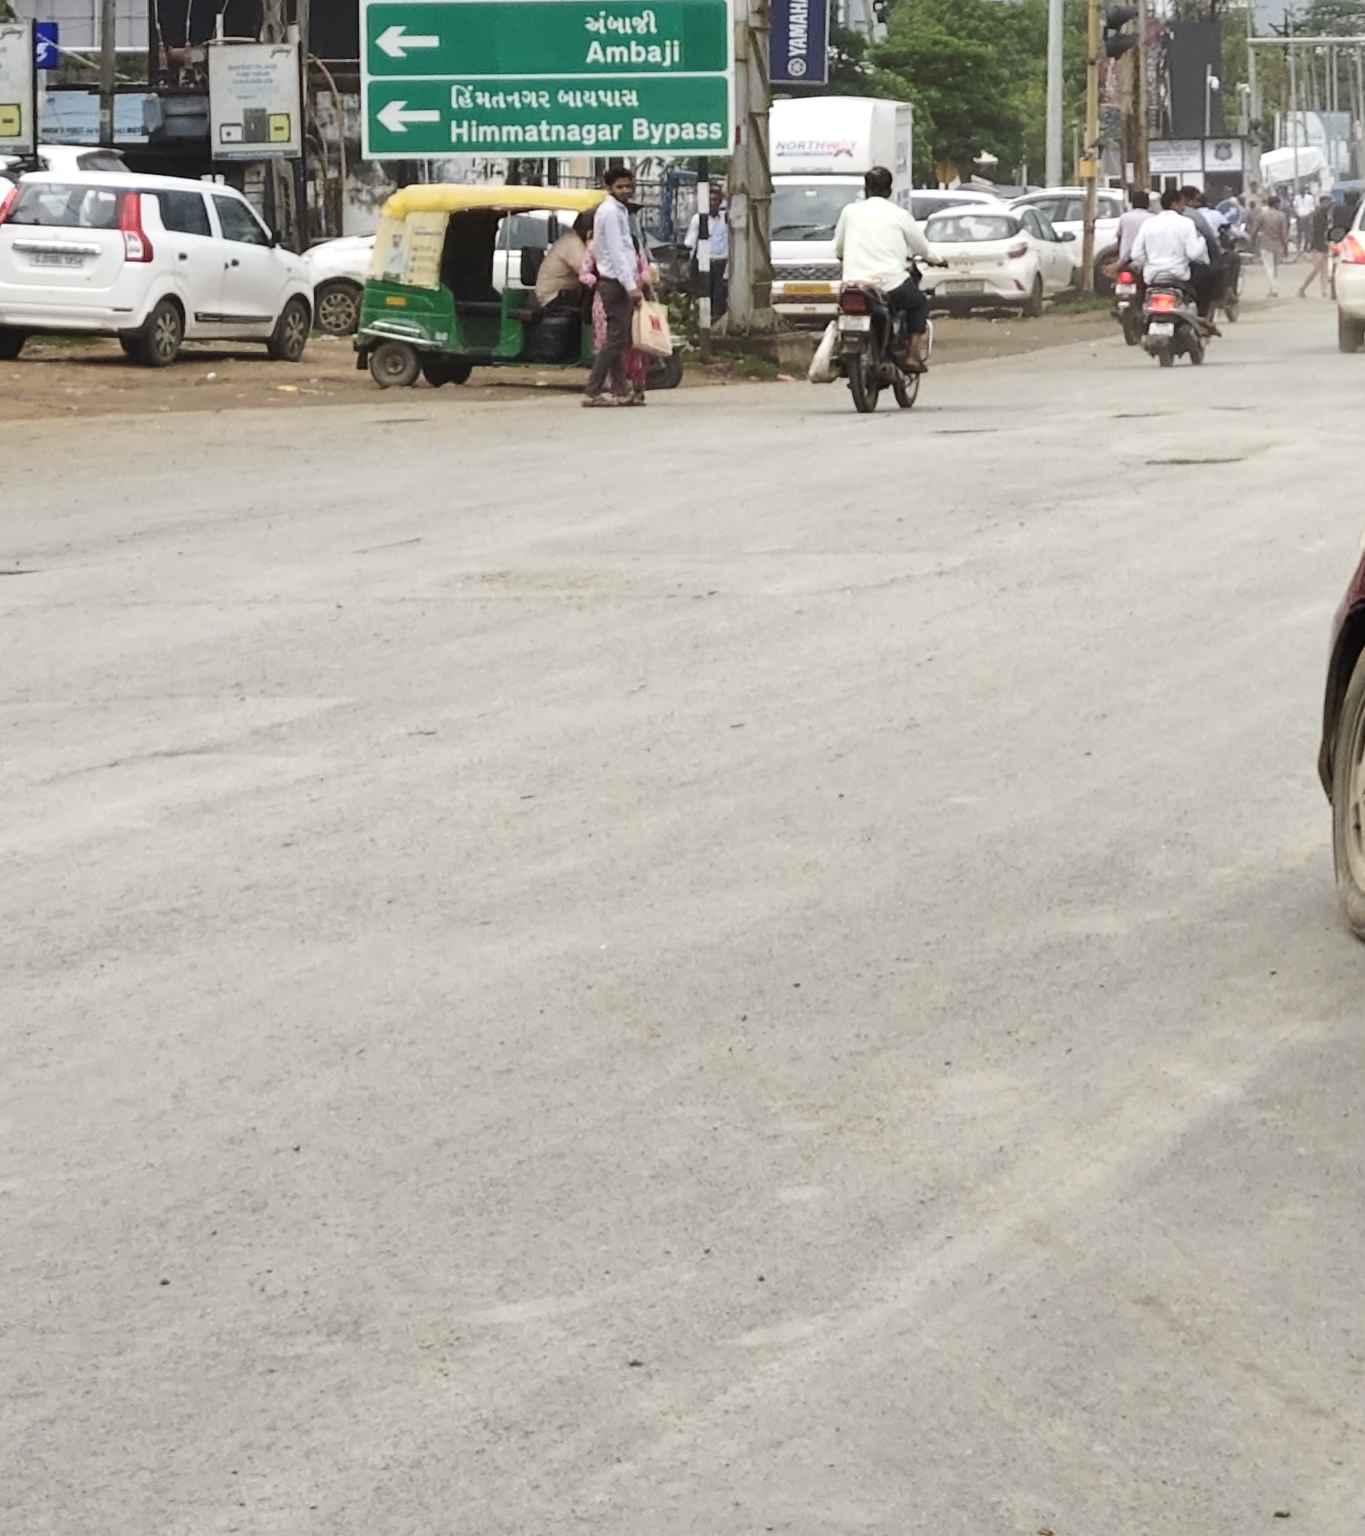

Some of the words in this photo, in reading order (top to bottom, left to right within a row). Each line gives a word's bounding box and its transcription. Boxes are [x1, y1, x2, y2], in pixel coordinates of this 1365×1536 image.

[585, 10, 657, 34] અંબાજી
[586, 40, 680, 66] Ambaji
[451, 85, 550, 109] હિંમતનગર
[557, 89, 639, 108] બાયપાસ
[451, 120, 623, 145] Himmatnagar
[632, 118, 722, 144] Bypass
